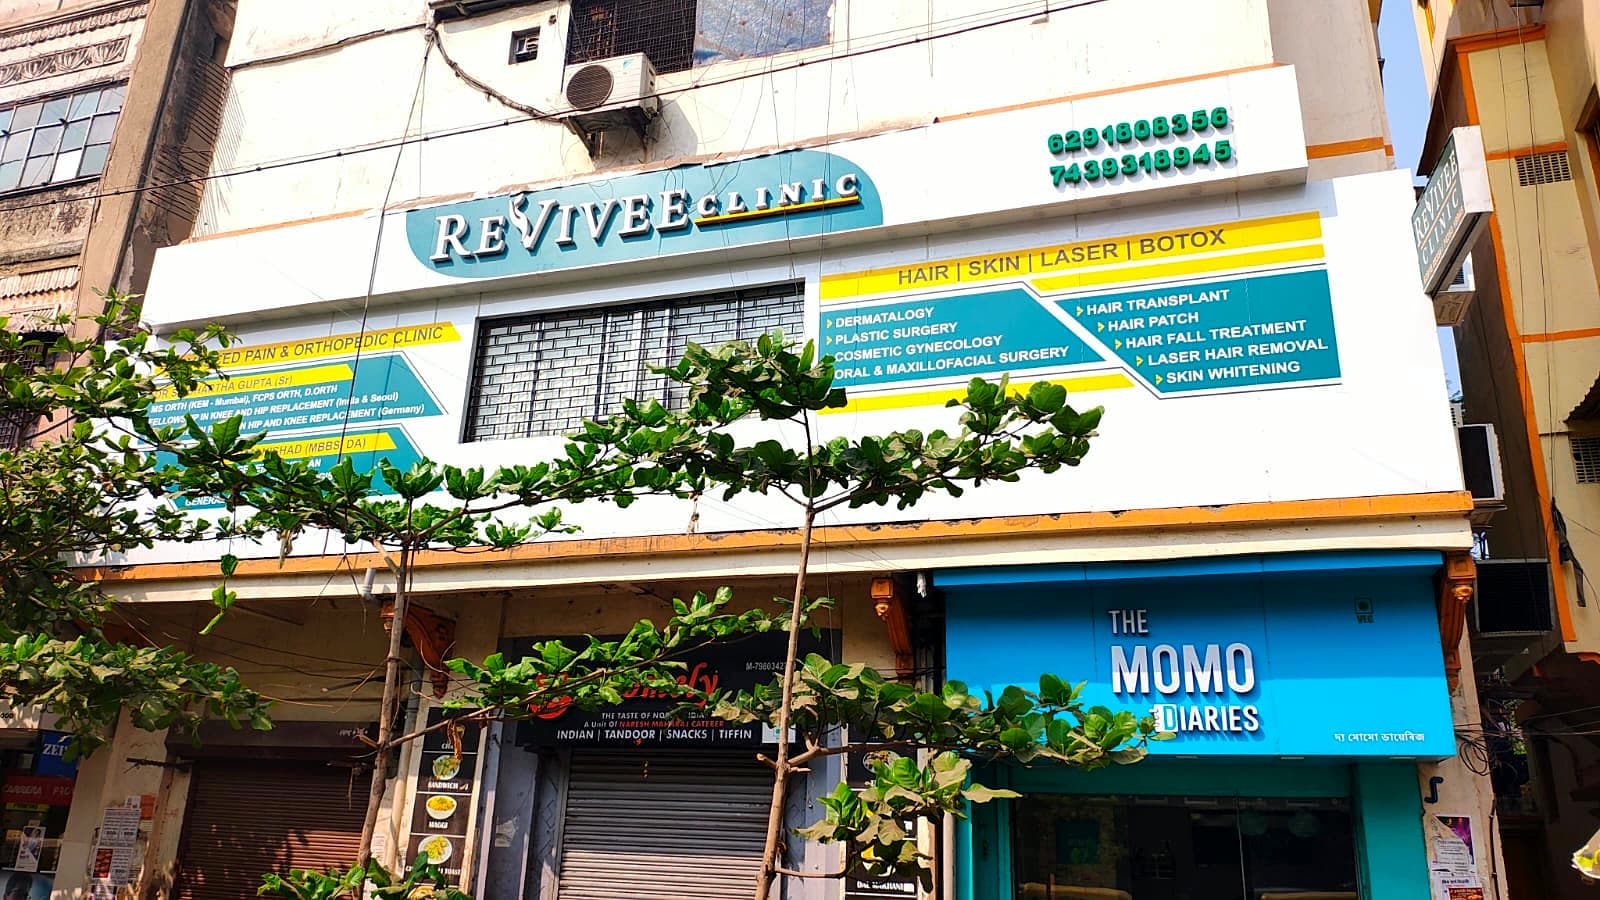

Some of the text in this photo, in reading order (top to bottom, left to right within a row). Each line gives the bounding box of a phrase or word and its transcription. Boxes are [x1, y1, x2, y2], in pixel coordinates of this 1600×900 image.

[1047, 107, 1228, 154] 6291808356
[1050, 140, 1232, 187] 7439318945
[697, 174, 858, 217] CLINIC
[1421, 188, 1459, 265] CLINIC
[898, 228, 1226, 286] HAIR SKIN LASER BOTOX
[1086, 289, 1230, 316] HAIR TRANSPLANT
[835, 306, 935, 329] DERMATALOGY
[1108, 312, 1199, 332] HAIR PATCH
[245, 347, 276, 361] PAIN
[280, 345, 289, 358] &
[294, 333, 388, 356] ORTHOPEDIC
[394, 326, 443, 344] CLINIC
[835, 322, 959, 345] PLASTIC SURGERY
[1126, 319, 1307, 349] HAIR FALL TREATMENT
[834, 335, 1003, 362] COSMETIC GYNECOLOGY
[1148, 338, 1328, 366] LASER HAIR REMOVAL
[834, 346, 1070, 380] ORAL & MAXILLOFACIAL SURGERY
[1166, 361, 1301, 384] SKIN WHITENING
[238, 377, 272, 391] GUPTA
[150, 403, 164, 413] MS
[165, 401, 187, 412] ORTH
[188, 400, 210, 412] (KEM
[253, 392, 275, 402] FCPS
[304, 384, 338, 397] D.ORTH
[200, 413, 209, 421] IN
[210, 410, 234, 420] KNEE
[234, 407, 253, 417] AND
[254, 406, 269, 416] HIP
[270, 399, 336, 414] REPLACEMENT
[361, 395, 369, 403] &
[371, 391, 399, 402] Seoul)
[248, 421, 262, 430] HIP
[263, 419, 282, 428] AND
[283, 415, 309, 426] KNEE
[309, 408, 377, 424] REPLACEMENT
[378, 403, 425, 418] (Germany)
[346, 438, 366, 450] DA)
[1108, 609, 1149, 634] THE
[1356, 614, 1375, 624] VEG
[1111, 643, 1256, 694] MOMO
[617, 711, 640, 719] TASTE
[640, 711, 651, 719] OF
[619, 720, 650, 728] NARESH
[691, 720, 725, 728] CATERER
[1162, 704, 1260, 732] DIARIES
[557, 728, 752, 740] INDIAN TANDOOR SNACKS TIFFIN
